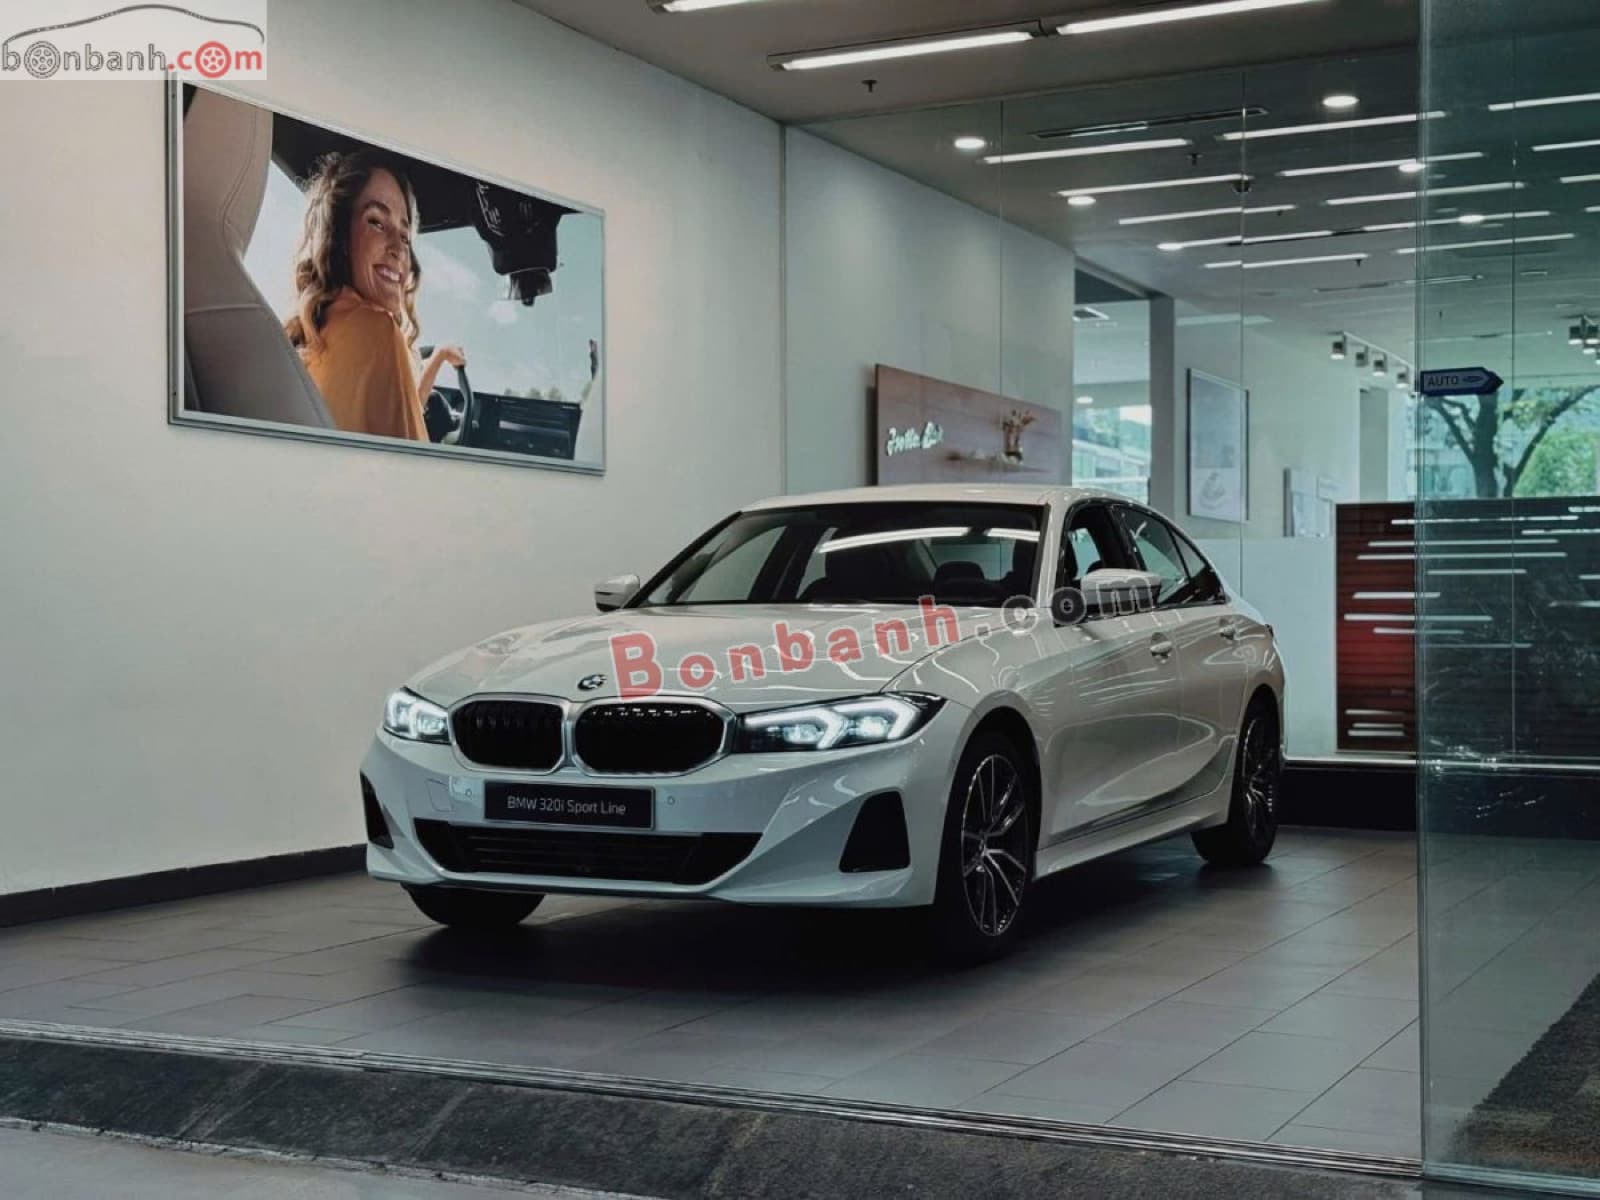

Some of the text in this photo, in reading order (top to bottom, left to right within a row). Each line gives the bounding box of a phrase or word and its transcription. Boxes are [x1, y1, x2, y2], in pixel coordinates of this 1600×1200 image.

[1428, 375, 1458, 385] AUTO
[507, 795, 626, 816] BMW 320i Sport Line
